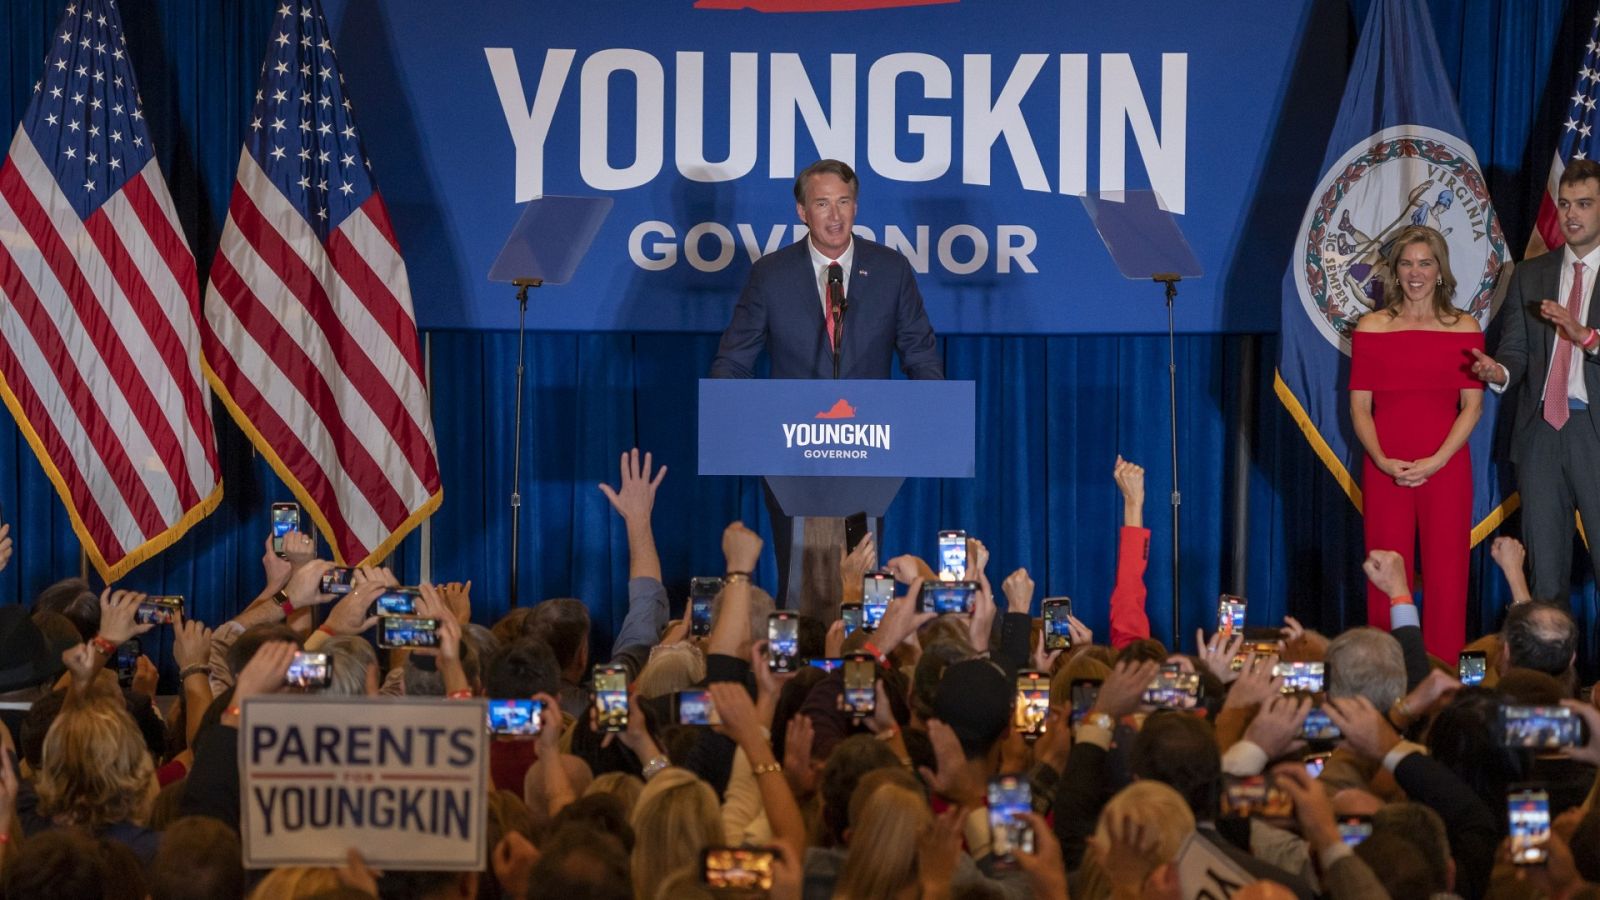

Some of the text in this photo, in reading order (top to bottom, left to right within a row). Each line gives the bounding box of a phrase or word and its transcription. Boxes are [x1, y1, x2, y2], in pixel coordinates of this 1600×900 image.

[484, 47, 1189, 215] YOUNGKIN
[1427, 163, 1486, 242] VIRGINIA
[628, 220, 1039, 275] GOVNOR
[1325, 232, 1349, 307] SIC SEMPER
[782, 423, 891, 450] YOUNGKIN
[804, 449, 868, 459] GOVERNOR
[252, 724, 477, 768] PARENTS
[254, 784, 472, 842] YOUNGKIN
